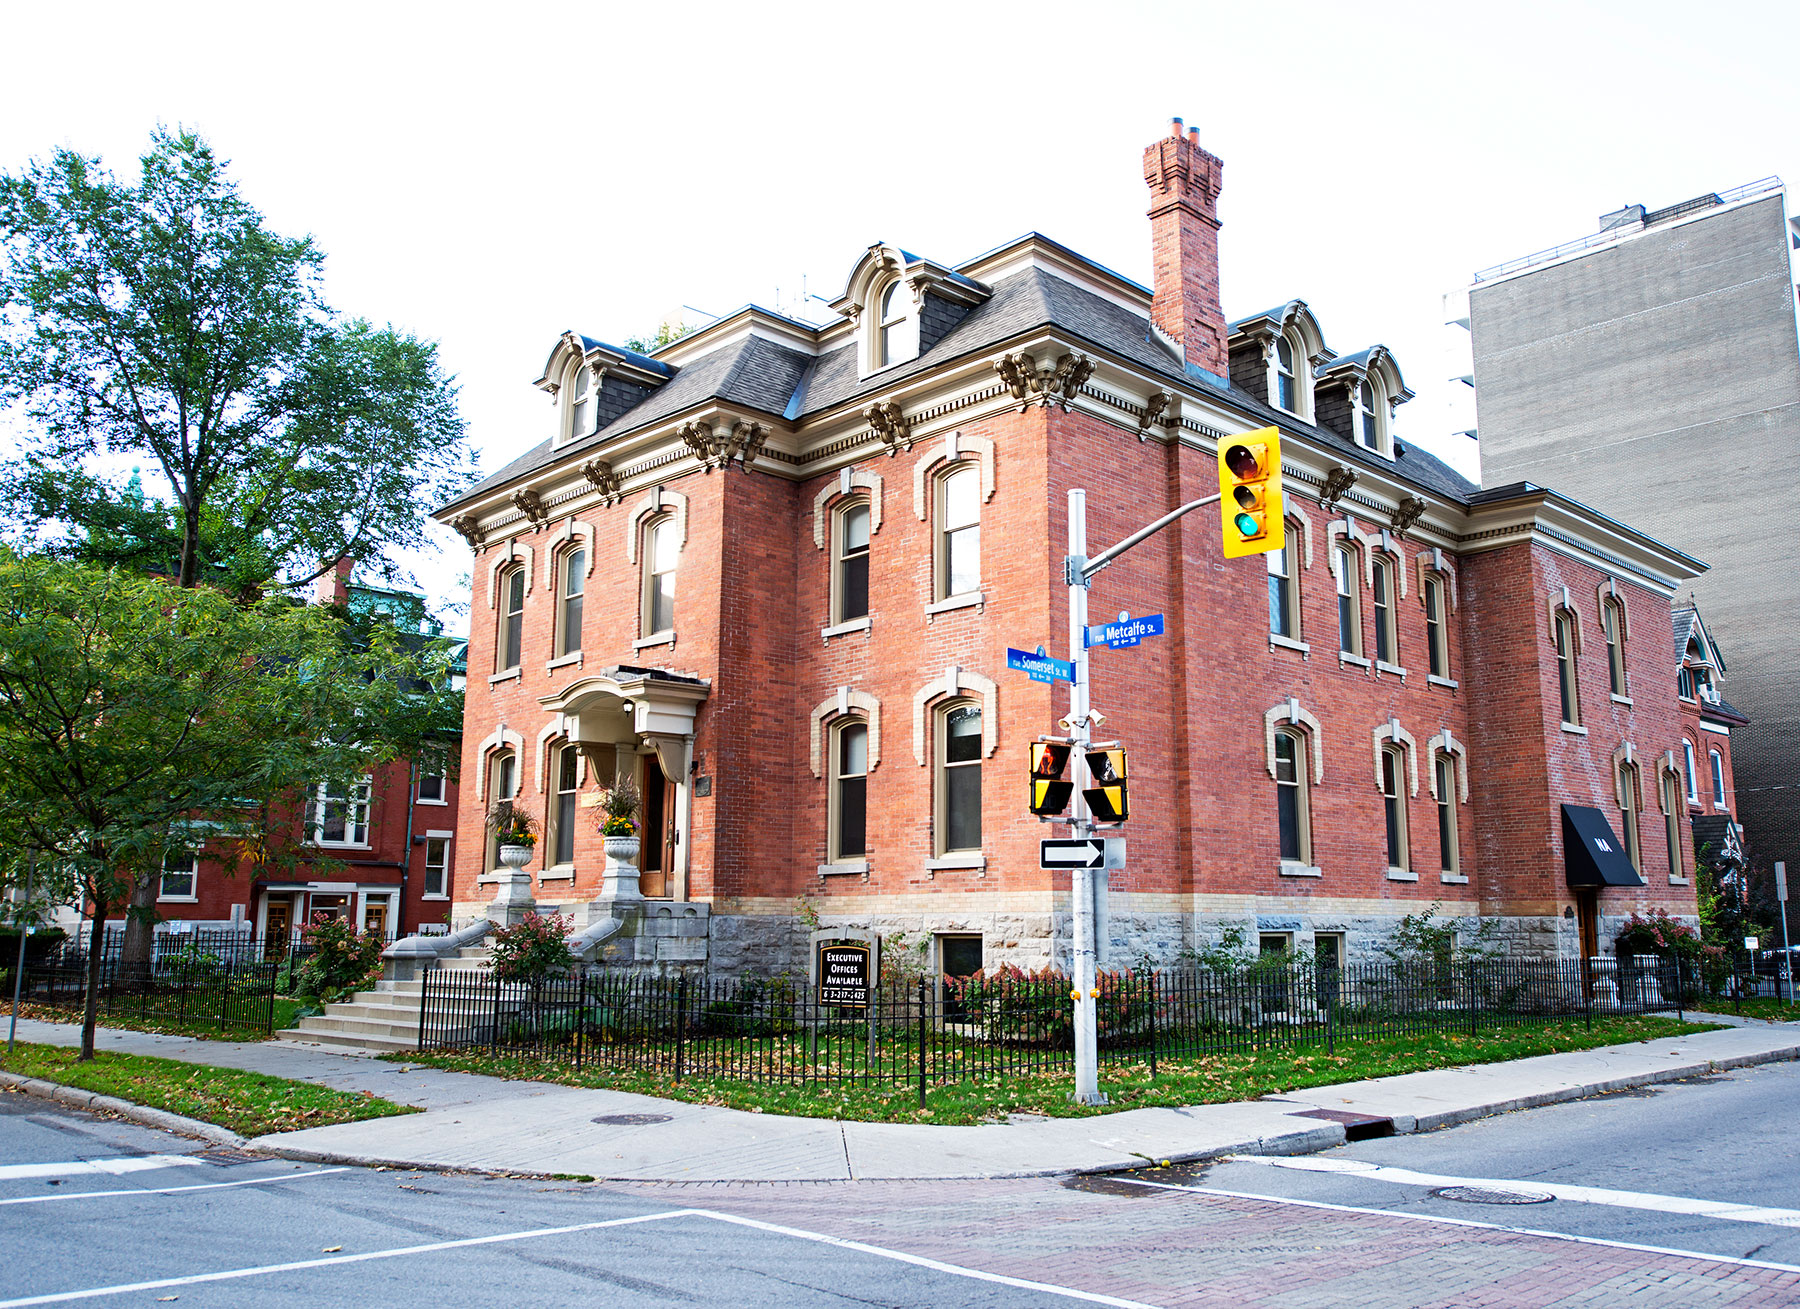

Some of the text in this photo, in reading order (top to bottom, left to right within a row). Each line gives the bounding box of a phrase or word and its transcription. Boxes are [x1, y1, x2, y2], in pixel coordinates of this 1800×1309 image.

[1095, 634, 1105, 642] rue
[1106, 621, 1146, 641] Metcalfe
[1012, 659, 1021, 667] rue
[1022, 655, 1054, 675] Somerset
[826, 952, 863, 962] EXECUTIVE
[831, 963, 858, 974] OFFICES
